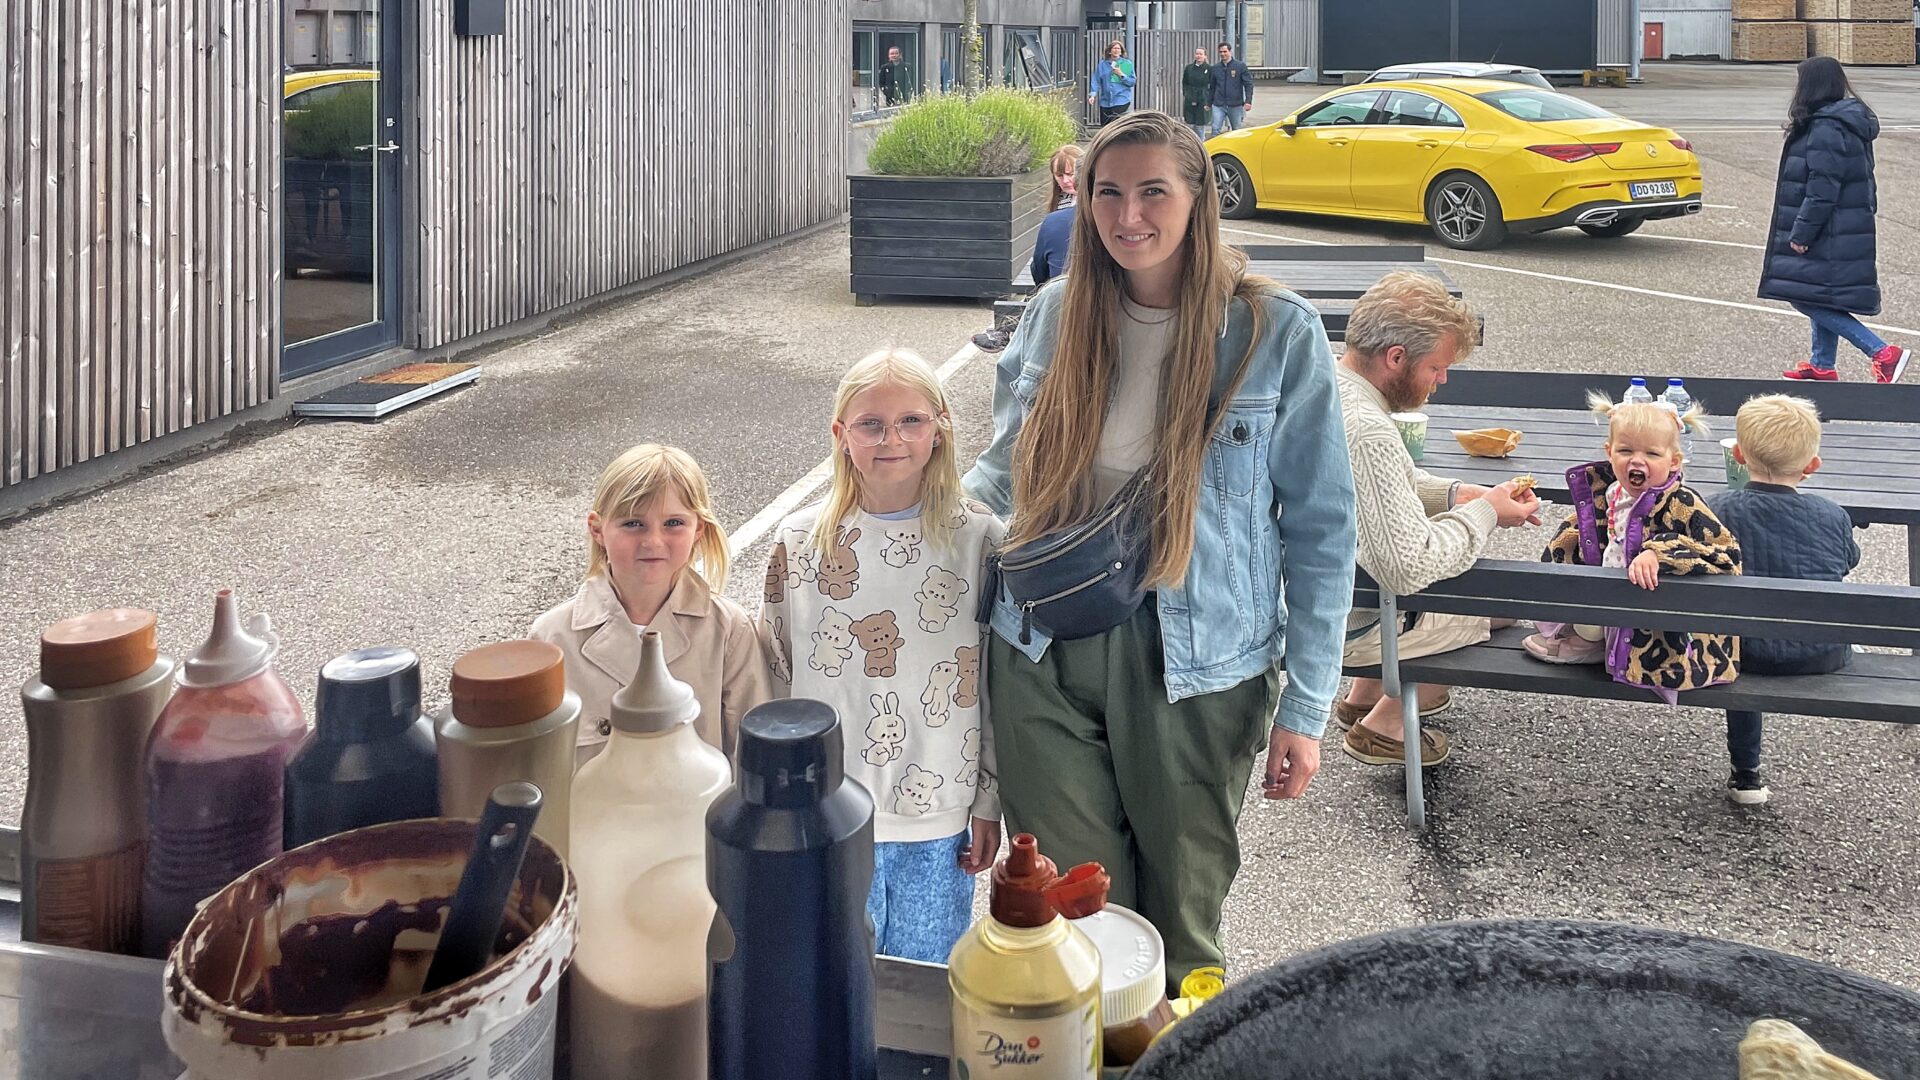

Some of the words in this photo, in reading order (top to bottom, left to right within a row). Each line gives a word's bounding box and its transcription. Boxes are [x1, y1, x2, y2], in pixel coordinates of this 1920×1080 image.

[1636, 185, 1649, 195] DD
[1649, 184, 1660, 194] 92
[1660, 183, 1675, 193] 885
[976, 1030, 1023, 1055] Dan
[990, 1049, 1044, 1069] Sukker
